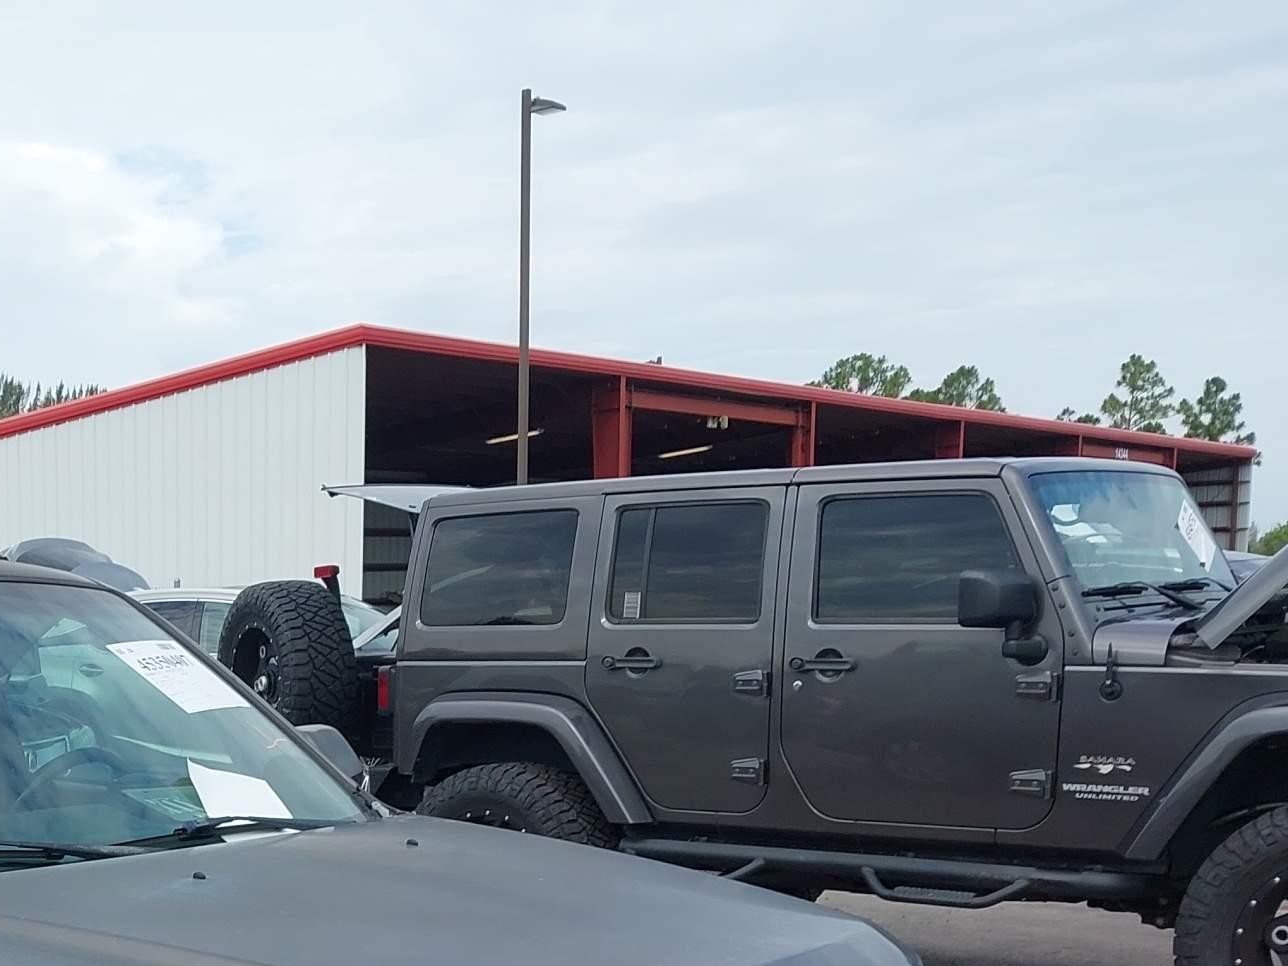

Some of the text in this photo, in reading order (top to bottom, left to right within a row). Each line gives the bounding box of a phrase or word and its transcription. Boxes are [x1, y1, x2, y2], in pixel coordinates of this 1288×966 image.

[1079, 754, 1136, 765] SAHARA
[1062, 782, 1151, 796] WRANGLER
[1074, 793, 1140, 802] UNLIMITED
